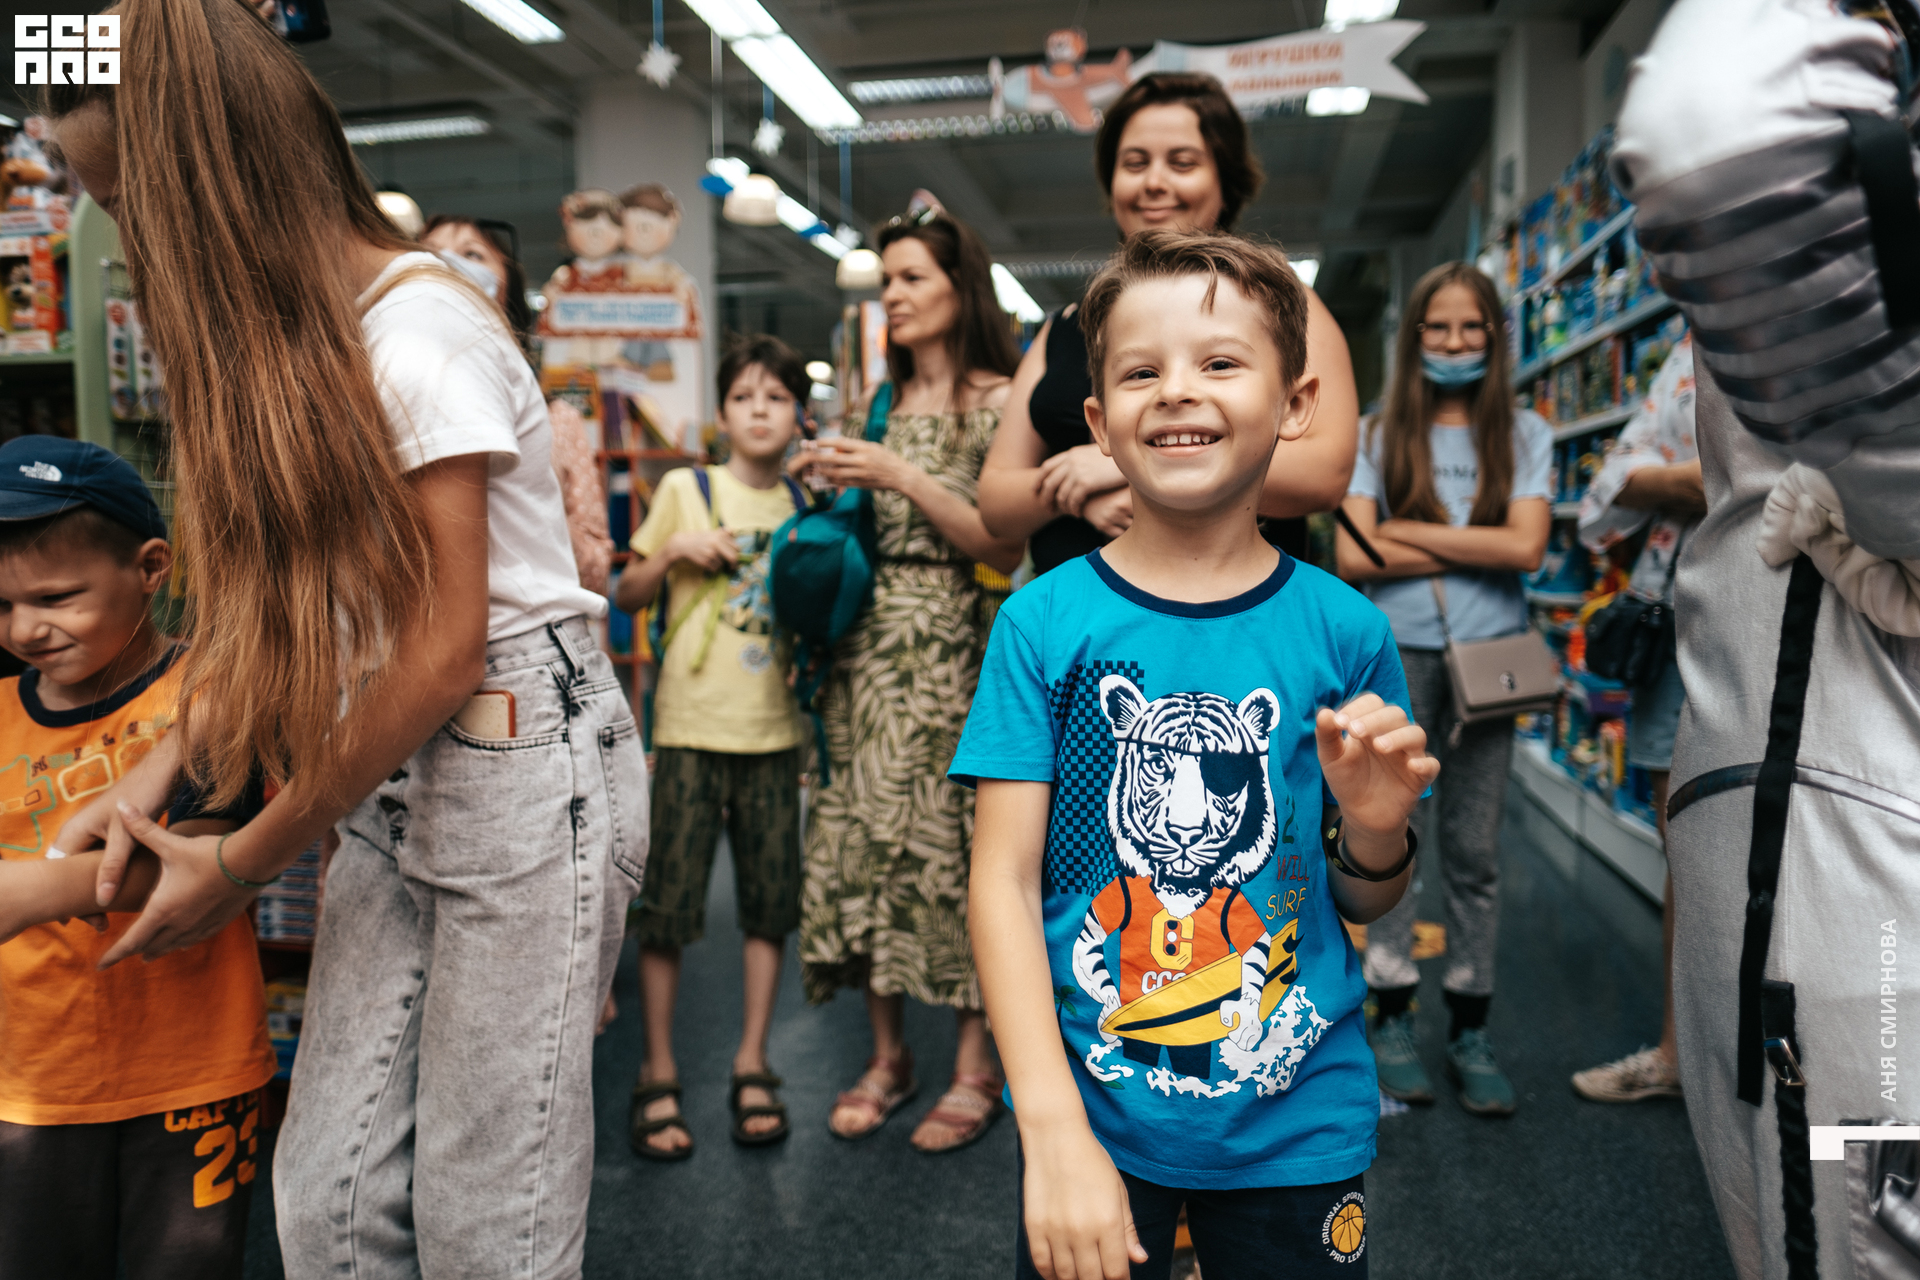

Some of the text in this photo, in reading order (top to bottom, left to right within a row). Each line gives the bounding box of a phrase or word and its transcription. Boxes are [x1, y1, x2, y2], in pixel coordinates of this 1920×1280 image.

[1277, 855, 1309, 881] WILL
[1266, 887, 1306, 920] SURF
[1322, 1191, 1364, 1245] ORIGINAL SPORTS
[1329, 1250, 1346, 1263] PRO
